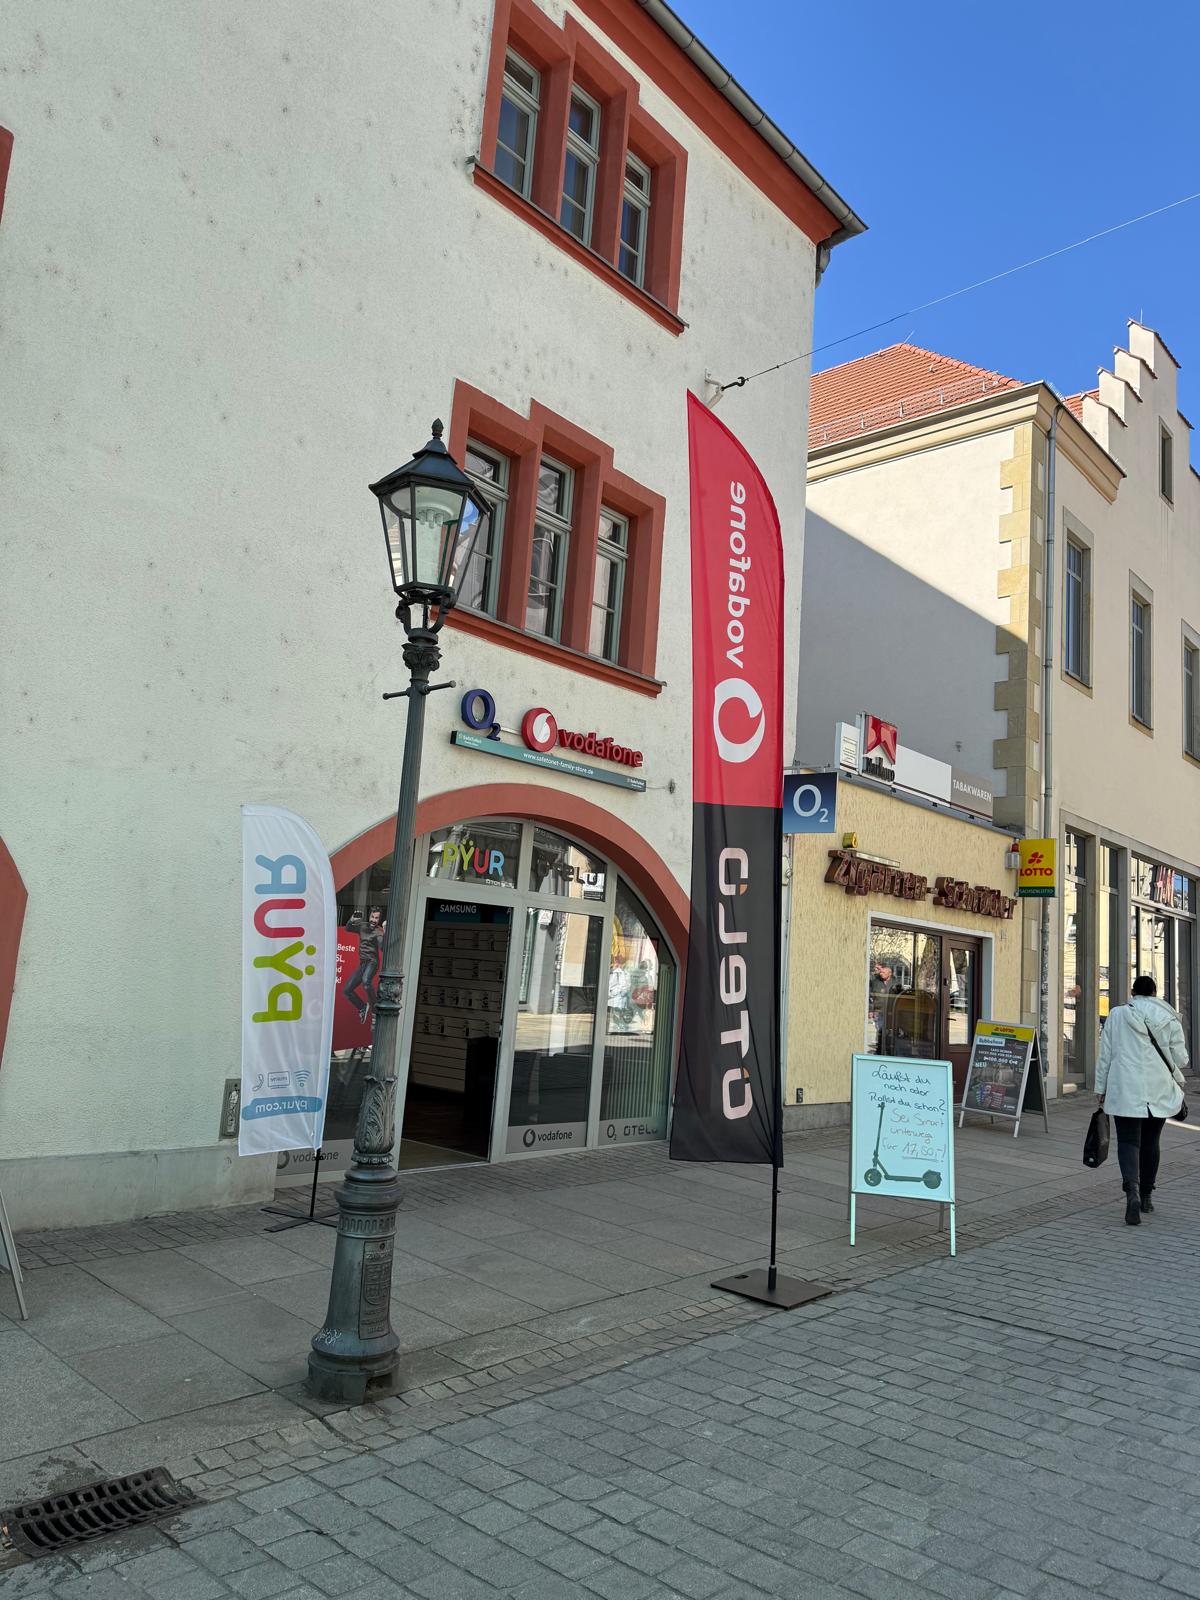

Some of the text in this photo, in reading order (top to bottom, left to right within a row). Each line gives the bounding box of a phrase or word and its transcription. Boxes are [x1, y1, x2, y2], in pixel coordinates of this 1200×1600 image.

[560, 729, 644, 767] vodafone
[952, 779, 992, 802] TABAKWAREN
[442, 839, 505, 878] PŸUR
[1019, 867, 1053, 877] LOTTO
[440, 904, 477, 914] SAMSUNG
[337, 943, 356, 952] Beste
[915, 1075, 931, 1086] du
[883, 1082, 907, 1092] noch
[897, 1099, 912, 1108] du
[890, 1108, 910, 1124] Sei
[537, 1130, 573, 1142] vodafone
[292, 1150, 339, 1162] vodaone
